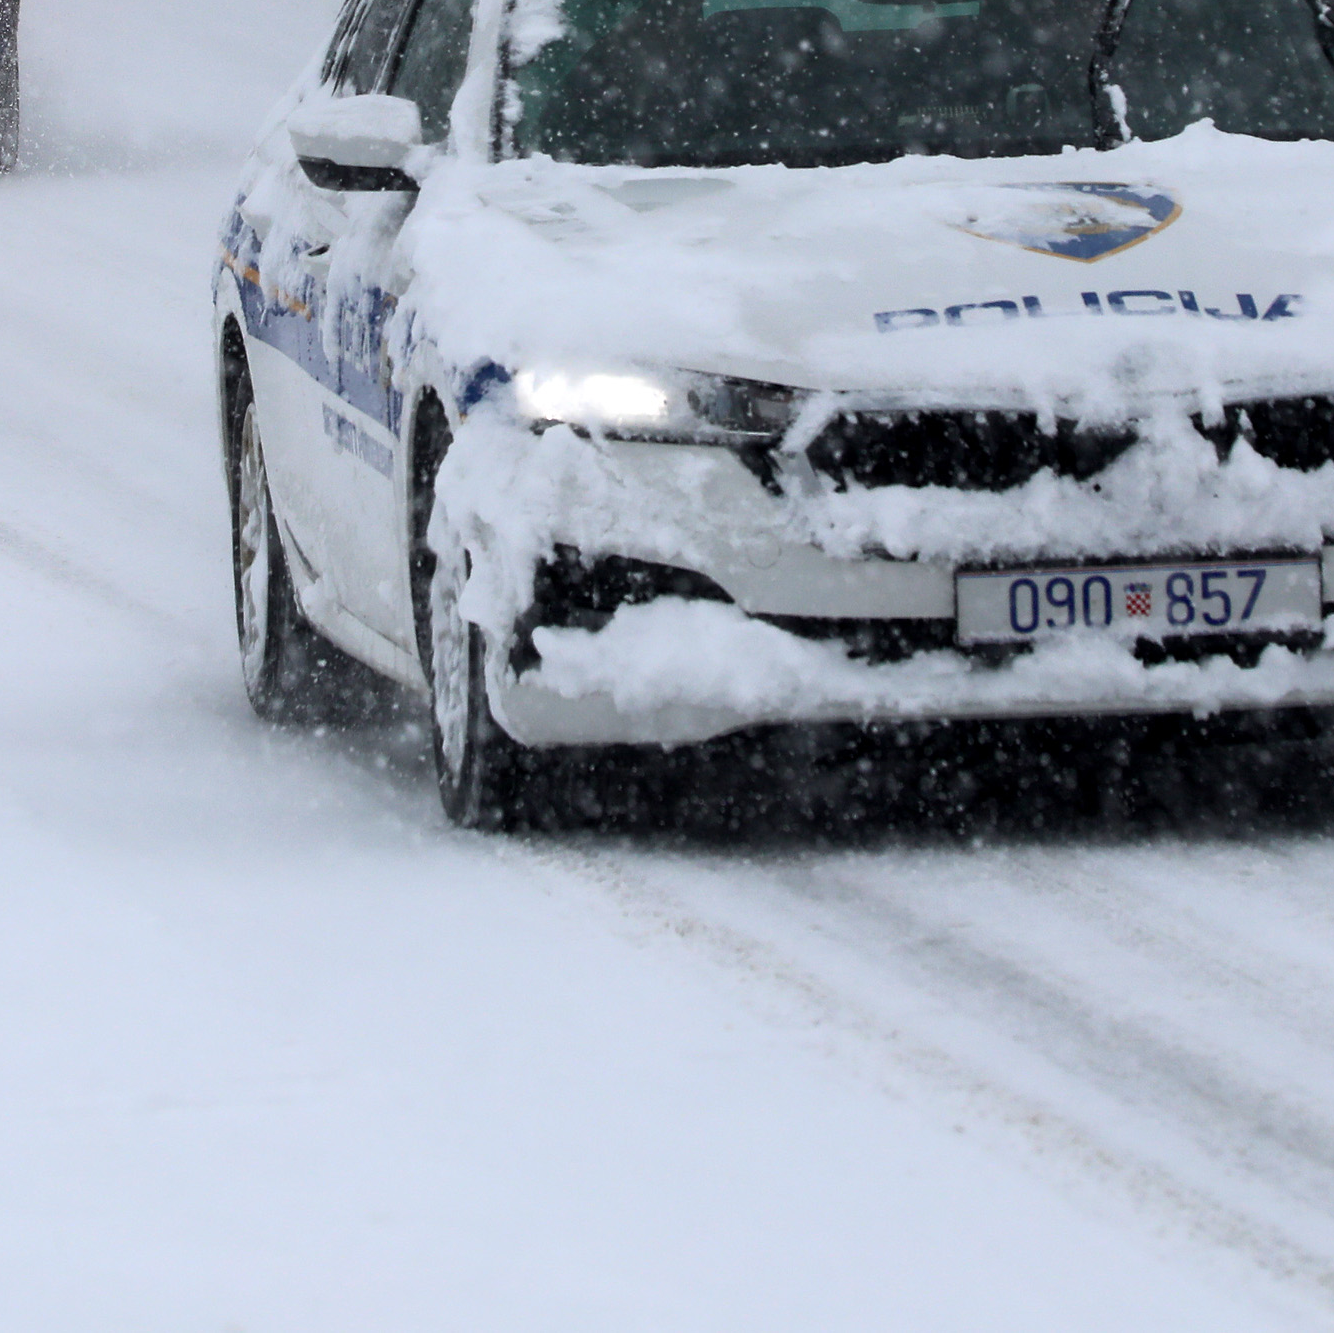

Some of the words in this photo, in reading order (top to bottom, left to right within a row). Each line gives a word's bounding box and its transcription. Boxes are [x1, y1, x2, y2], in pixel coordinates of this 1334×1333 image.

[872, 288, 1306, 333] POLICIJA
[1008, 574, 1113, 634] 090
[1165, 568, 1267, 627] 857
